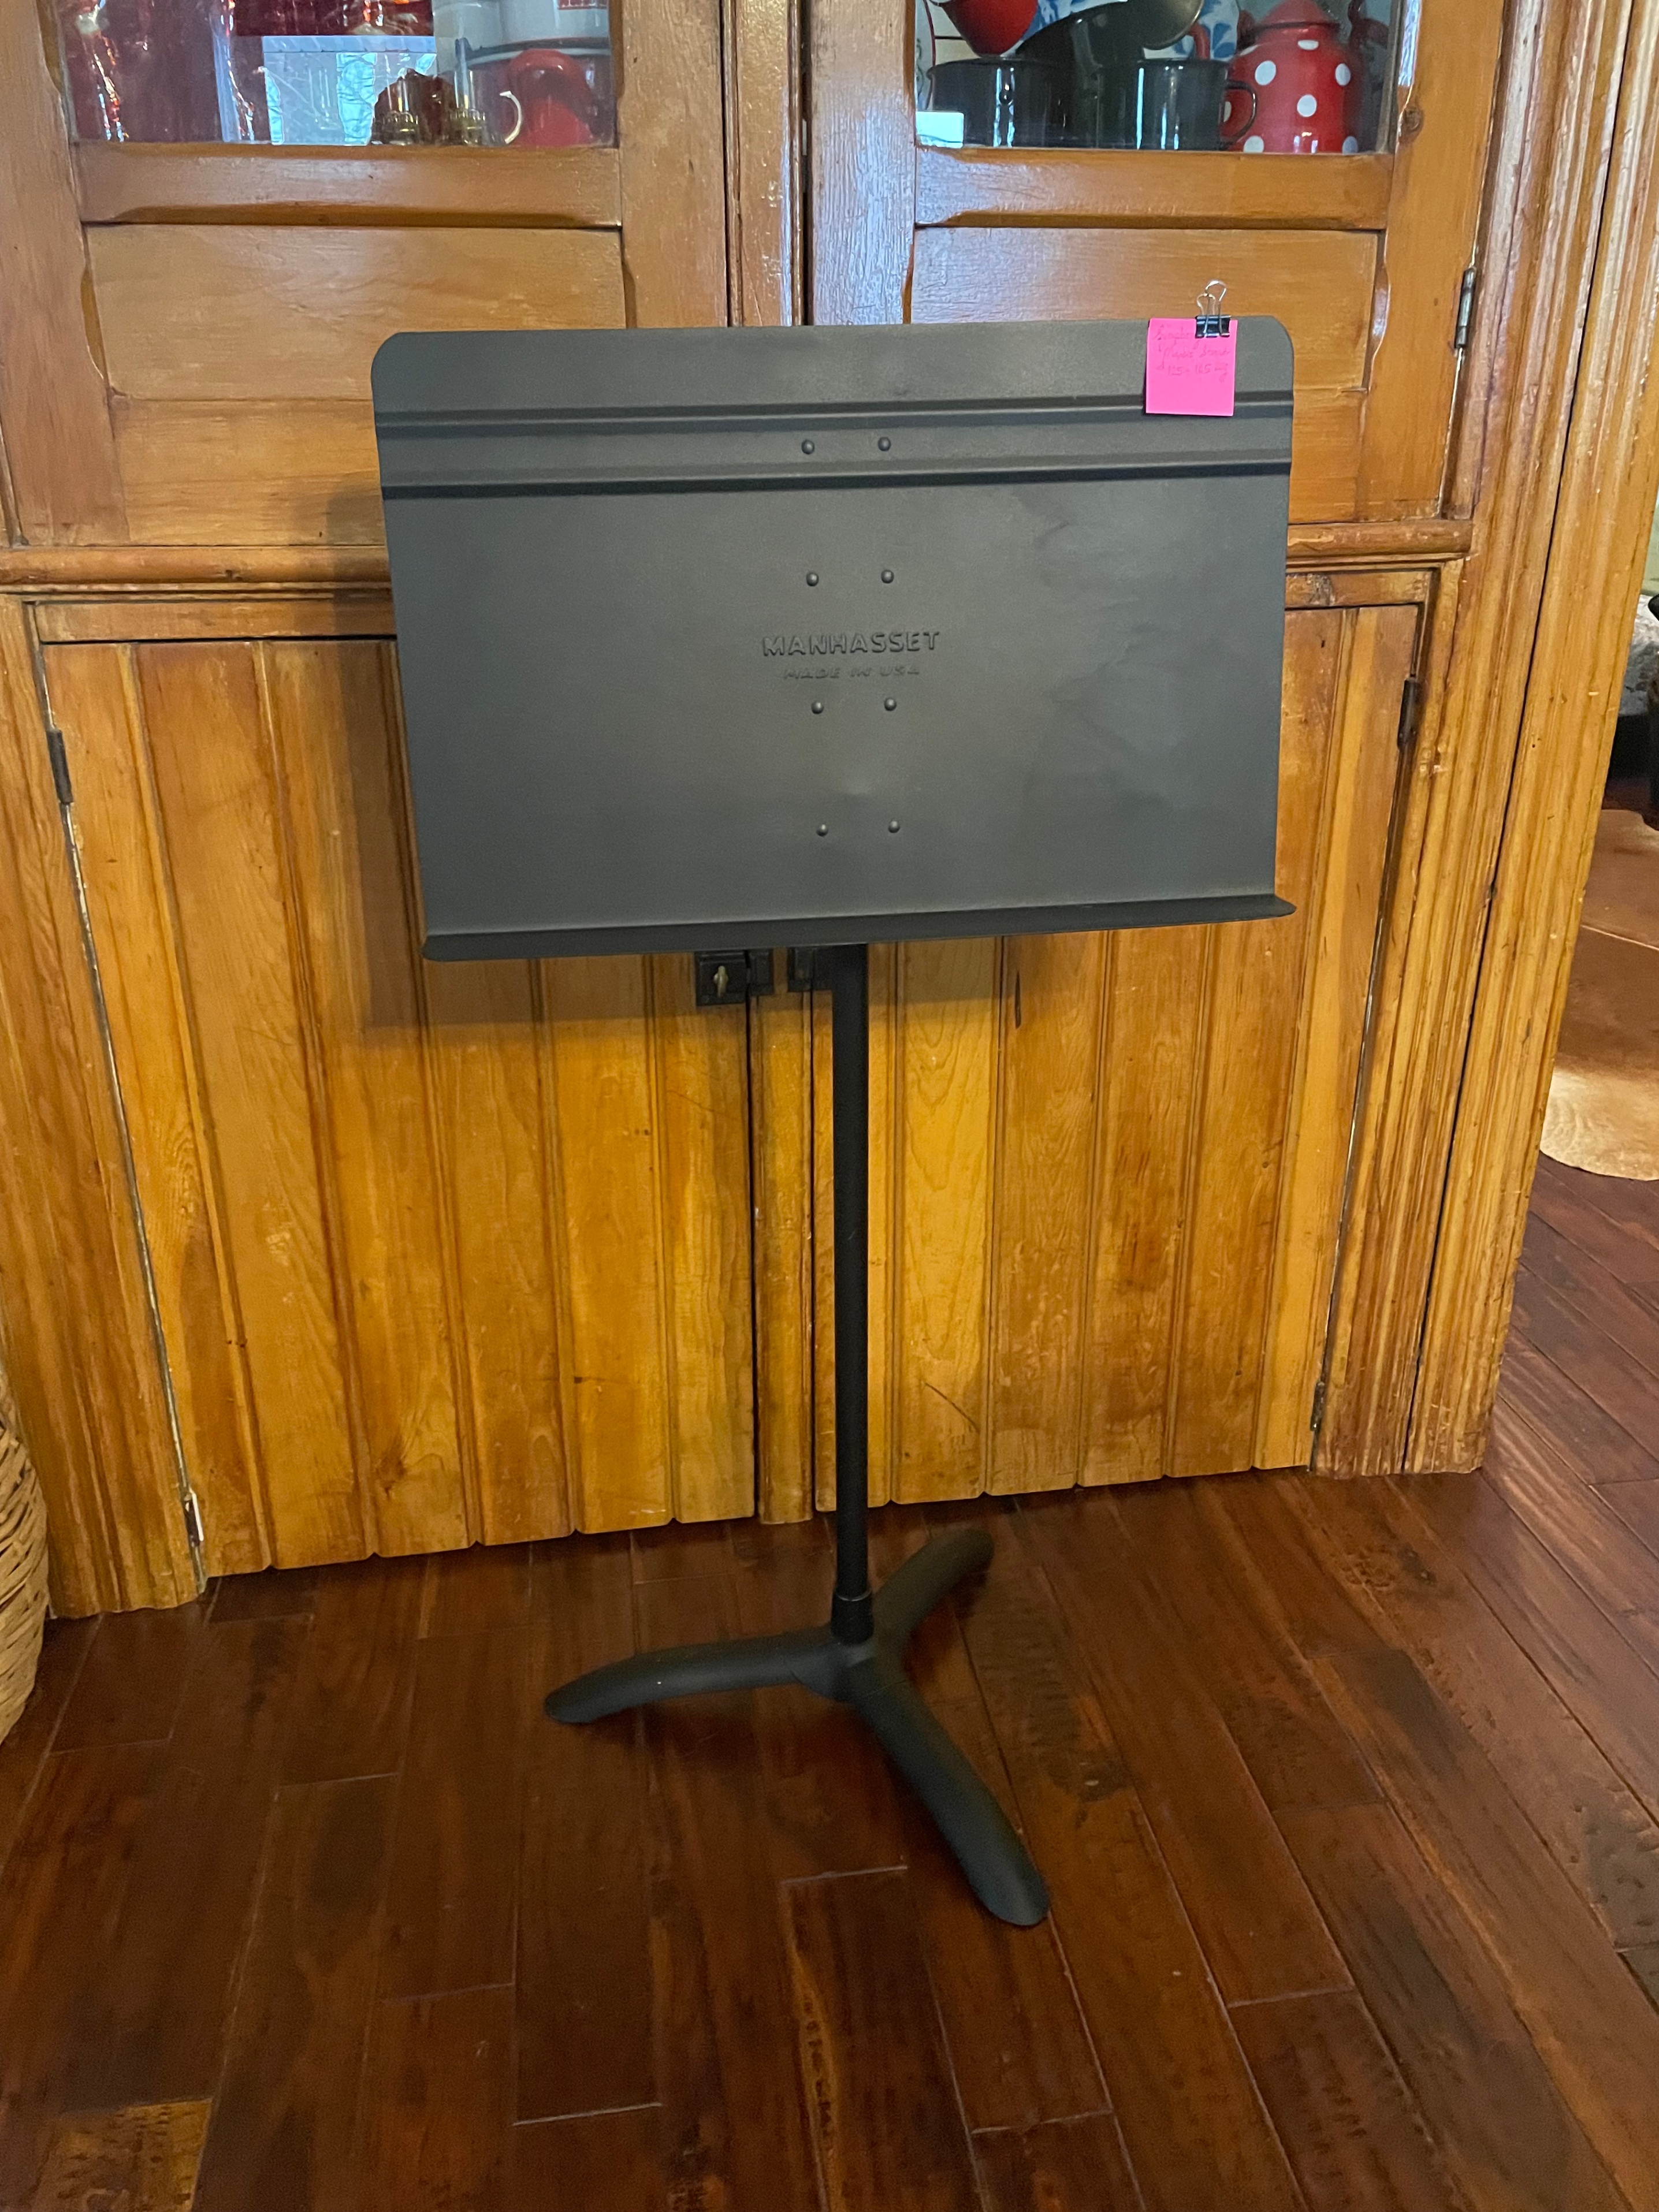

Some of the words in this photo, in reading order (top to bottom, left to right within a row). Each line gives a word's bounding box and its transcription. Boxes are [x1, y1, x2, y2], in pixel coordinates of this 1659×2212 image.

[762, 631, 940, 656] MANHASSET
[783, 668, 840, 679] MADE
[850, 666, 871, 677] IN
[879, 665, 920, 677] USA
